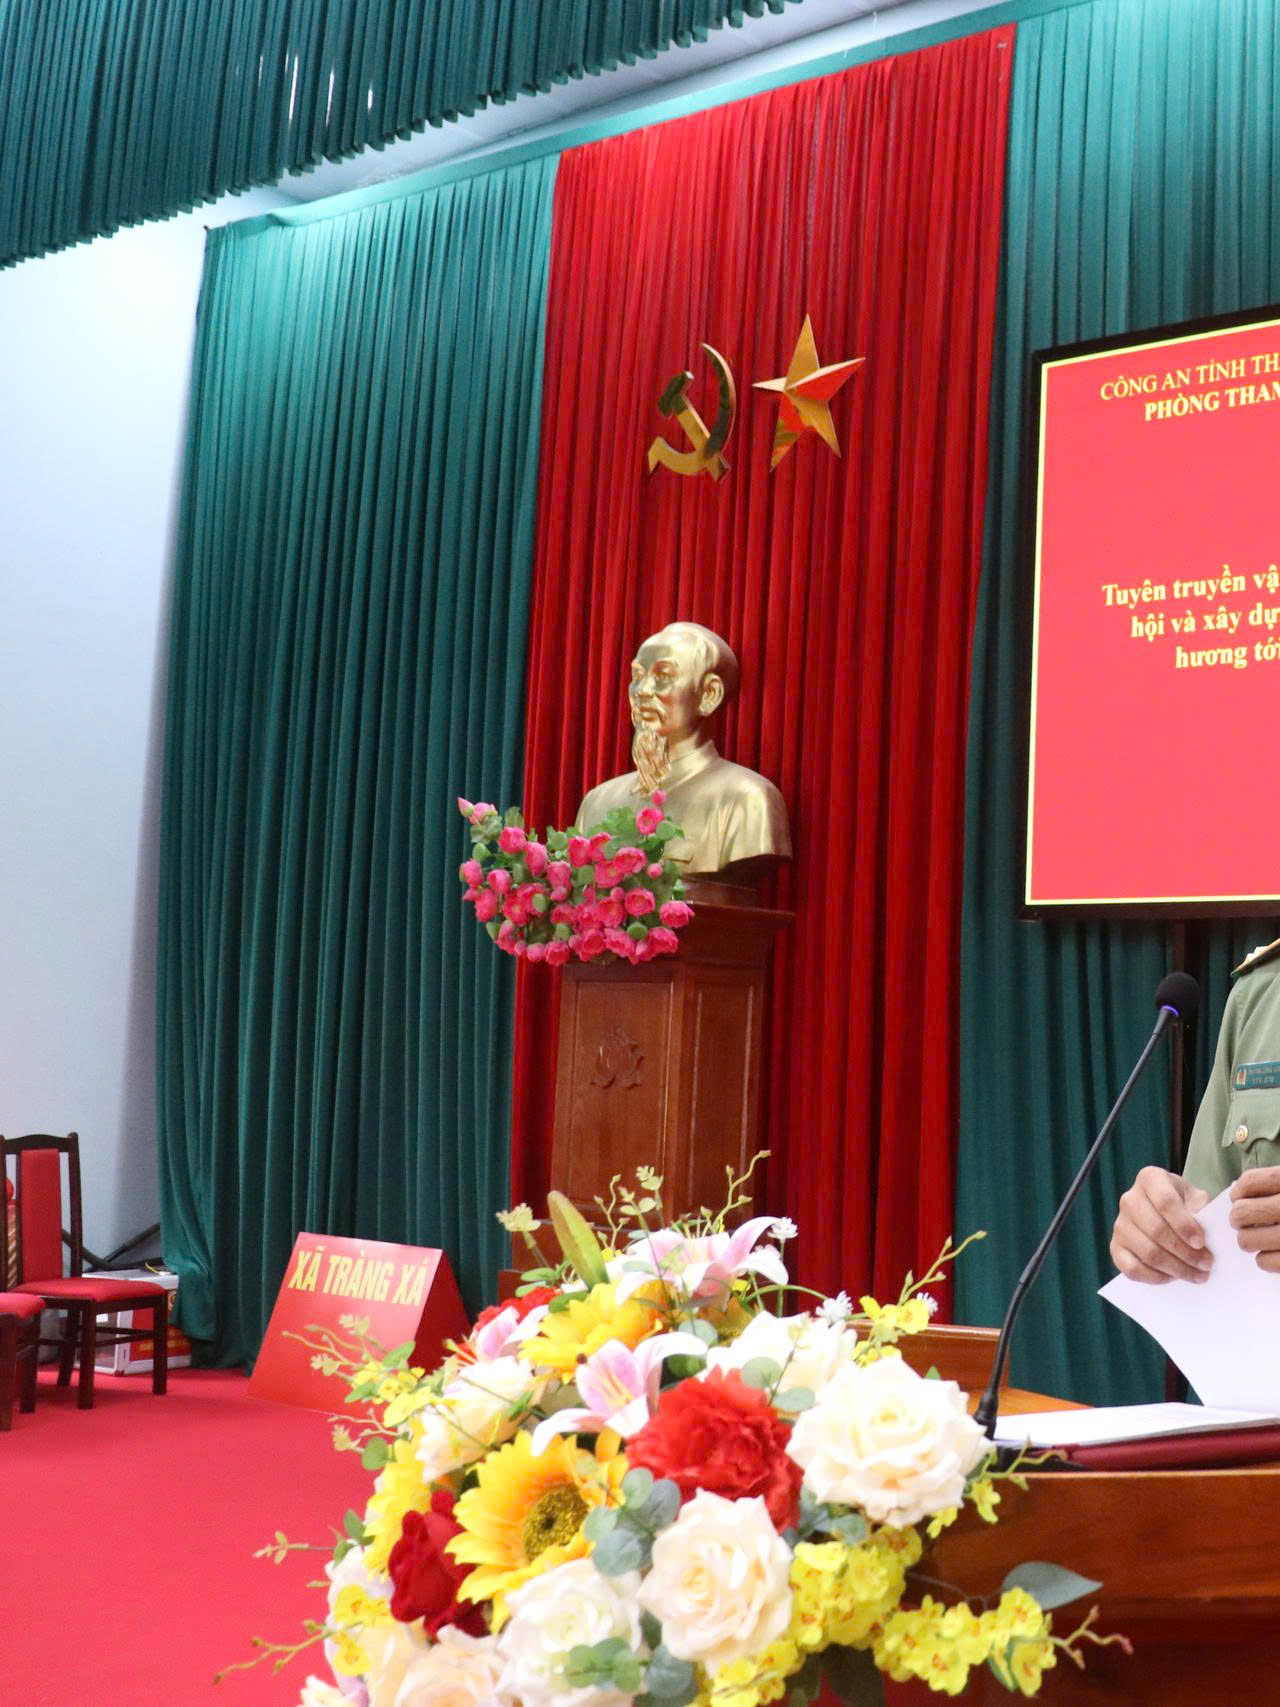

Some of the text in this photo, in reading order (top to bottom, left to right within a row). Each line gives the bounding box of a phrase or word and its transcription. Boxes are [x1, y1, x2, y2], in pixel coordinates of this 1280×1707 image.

[1099, 374, 1158, 401] CÔNG
[1161, 367, 1191, 391] AN
[1195, 358, 1246, 385] TỈNH
[1144, 391, 1220, 422] PHÒNG
[1101, 578, 1167, 610] Tuyên
[1172, 563, 1246, 601] truyền
[1130, 612, 1165, 643] hội
[1170, 609, 1197, 634] và
[1202, 605, 1243, 635] xây
[1175, 645, 1249, 670] hương
[391, 1257, 431, 1307] XÁ
